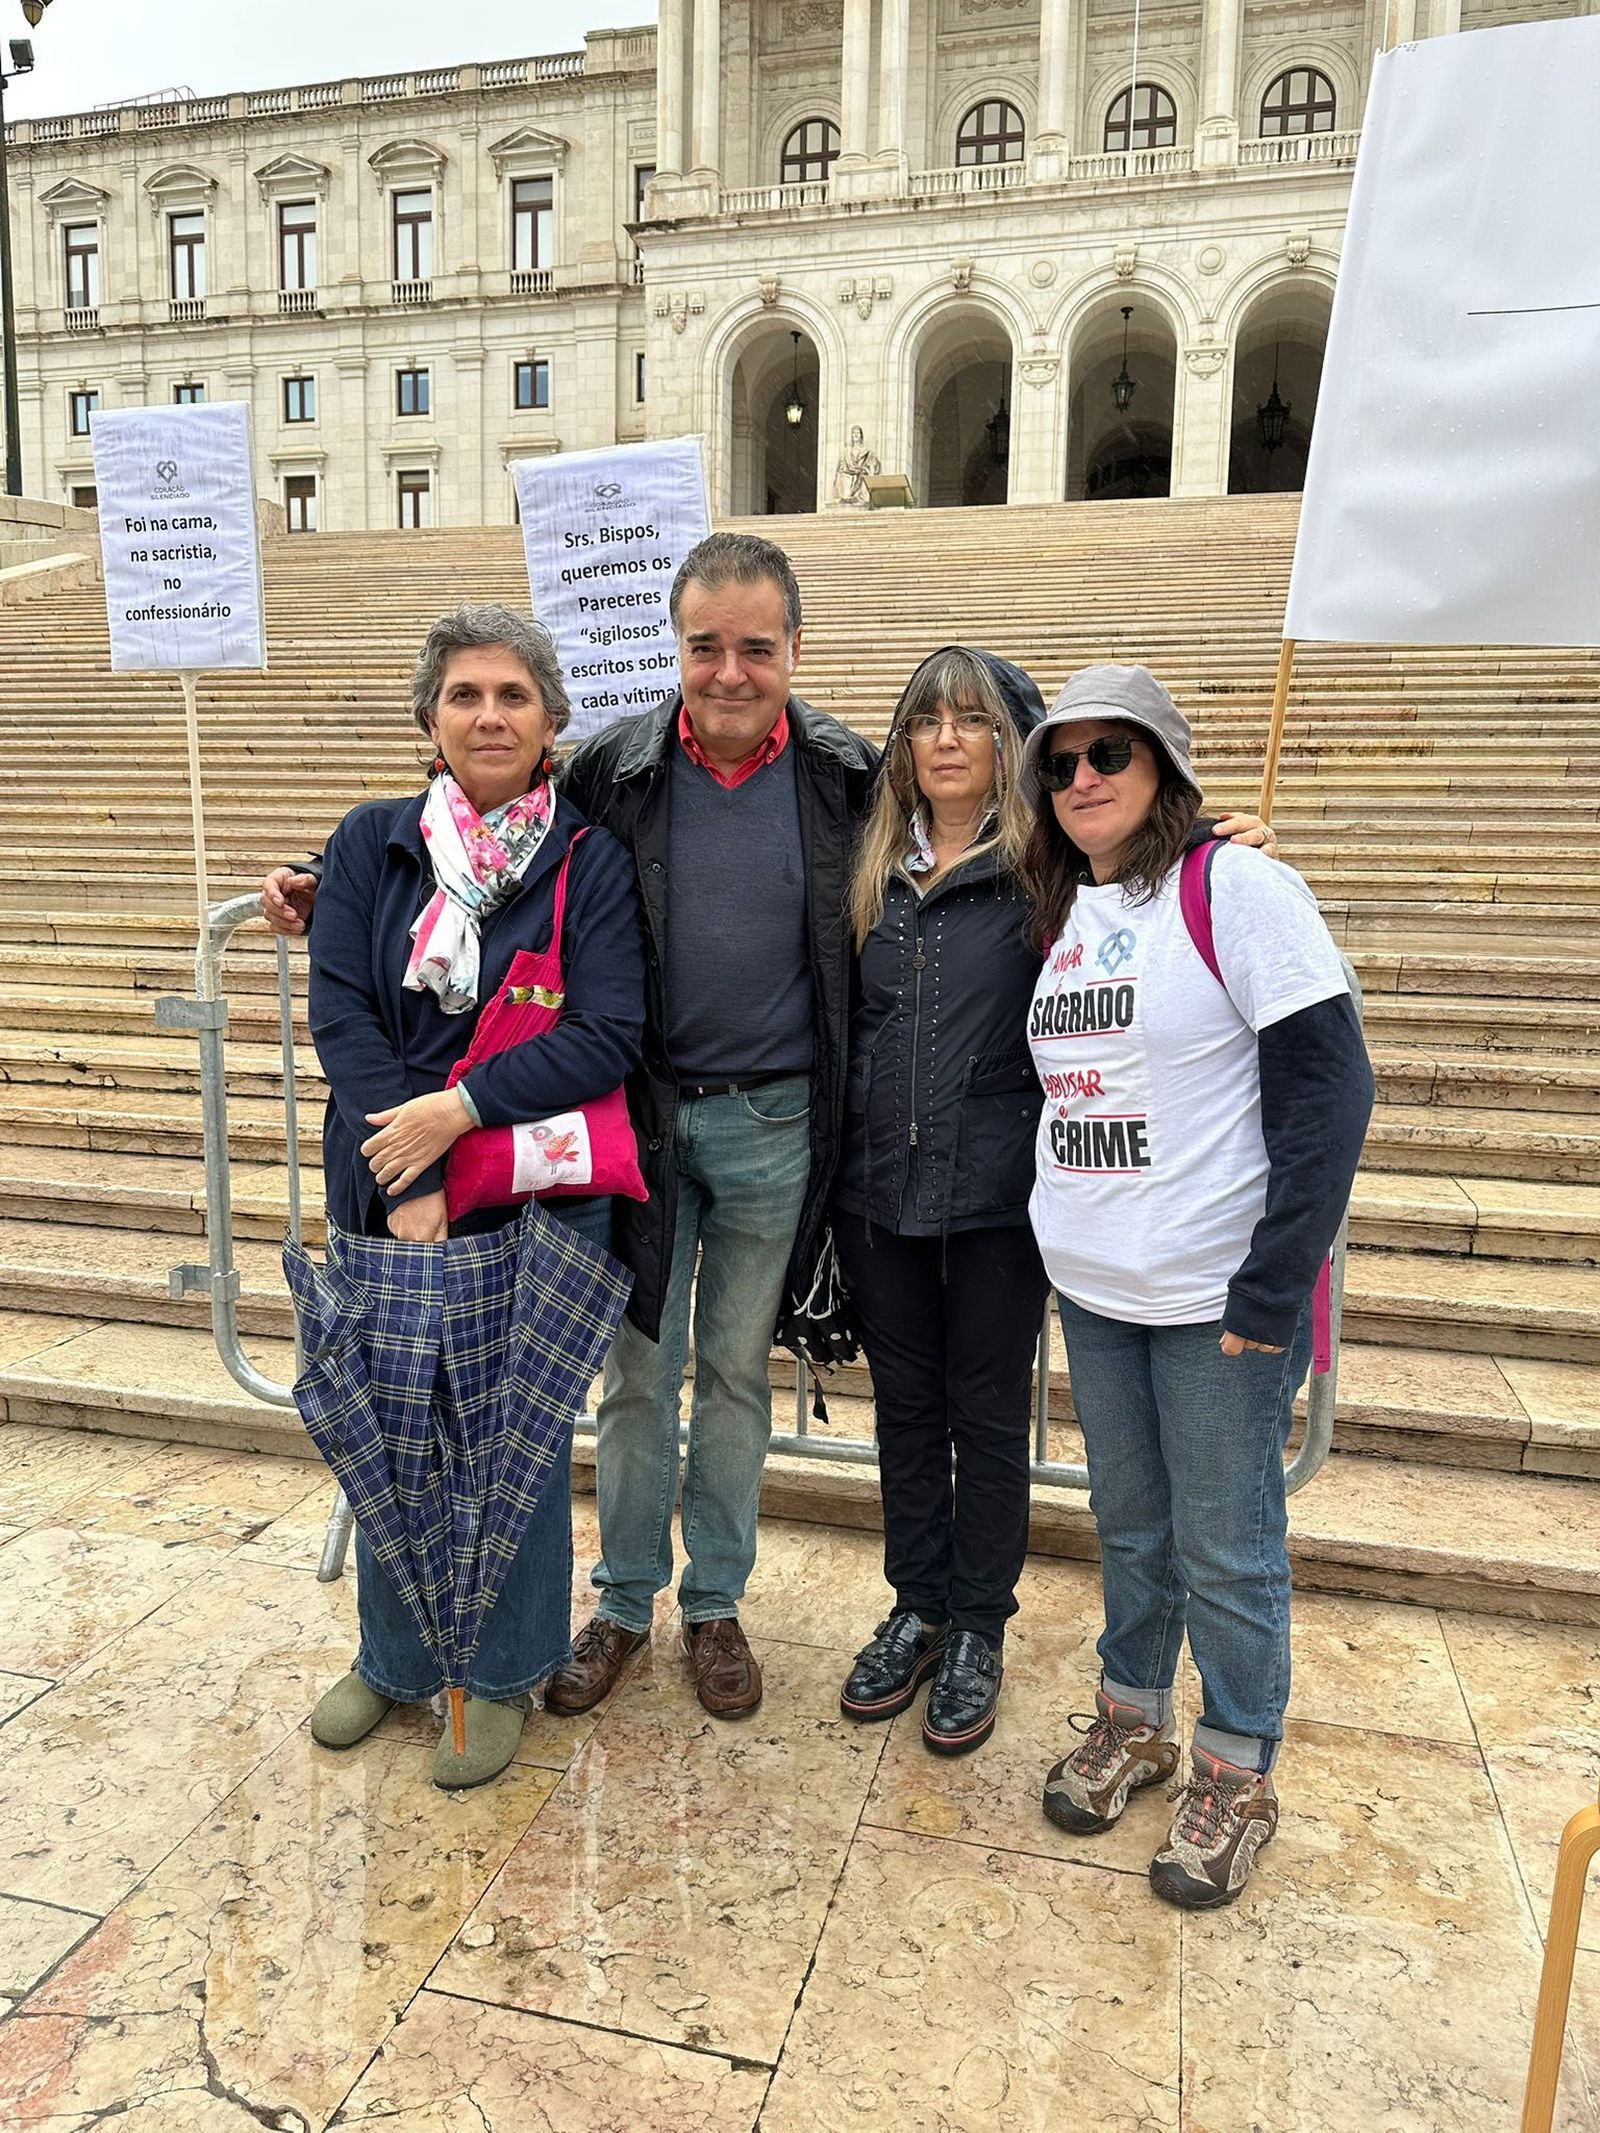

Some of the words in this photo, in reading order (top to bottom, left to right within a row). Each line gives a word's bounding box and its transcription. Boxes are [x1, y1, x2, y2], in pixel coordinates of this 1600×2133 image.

[150, 492, 190, 500] SILENCIADO
[125, 516, 147, 533] Foi
[150, 519, 168, 531] na
[172, 516, 217, 531] cama,
[564, 532, 594, 548] Srs.
[600, 524, 660, 544] Bispos,
[130, 550, 148, 562] na
[152, 543, 217, 561] sacristia,
[561, 559, 647, 585] queremos
[652, 557, 671, 570] os
[163, 578, 182, 590] no
[125, 602, 231, 621] confessionário
[578, 591, 662, 612] Pareceres
[571, 659, 634, 678] escritos
[638, 652, 679, 671] sobr
[581, 691, 619, 709] cada
[1049, 943, 1084, 976] AMAR
[1031, 985, 1135, 1037] SAGRADO
[1043, 1069, 1105, 1099] ABUSAR
[1050, 1119, 1151, 1167] CRIME
